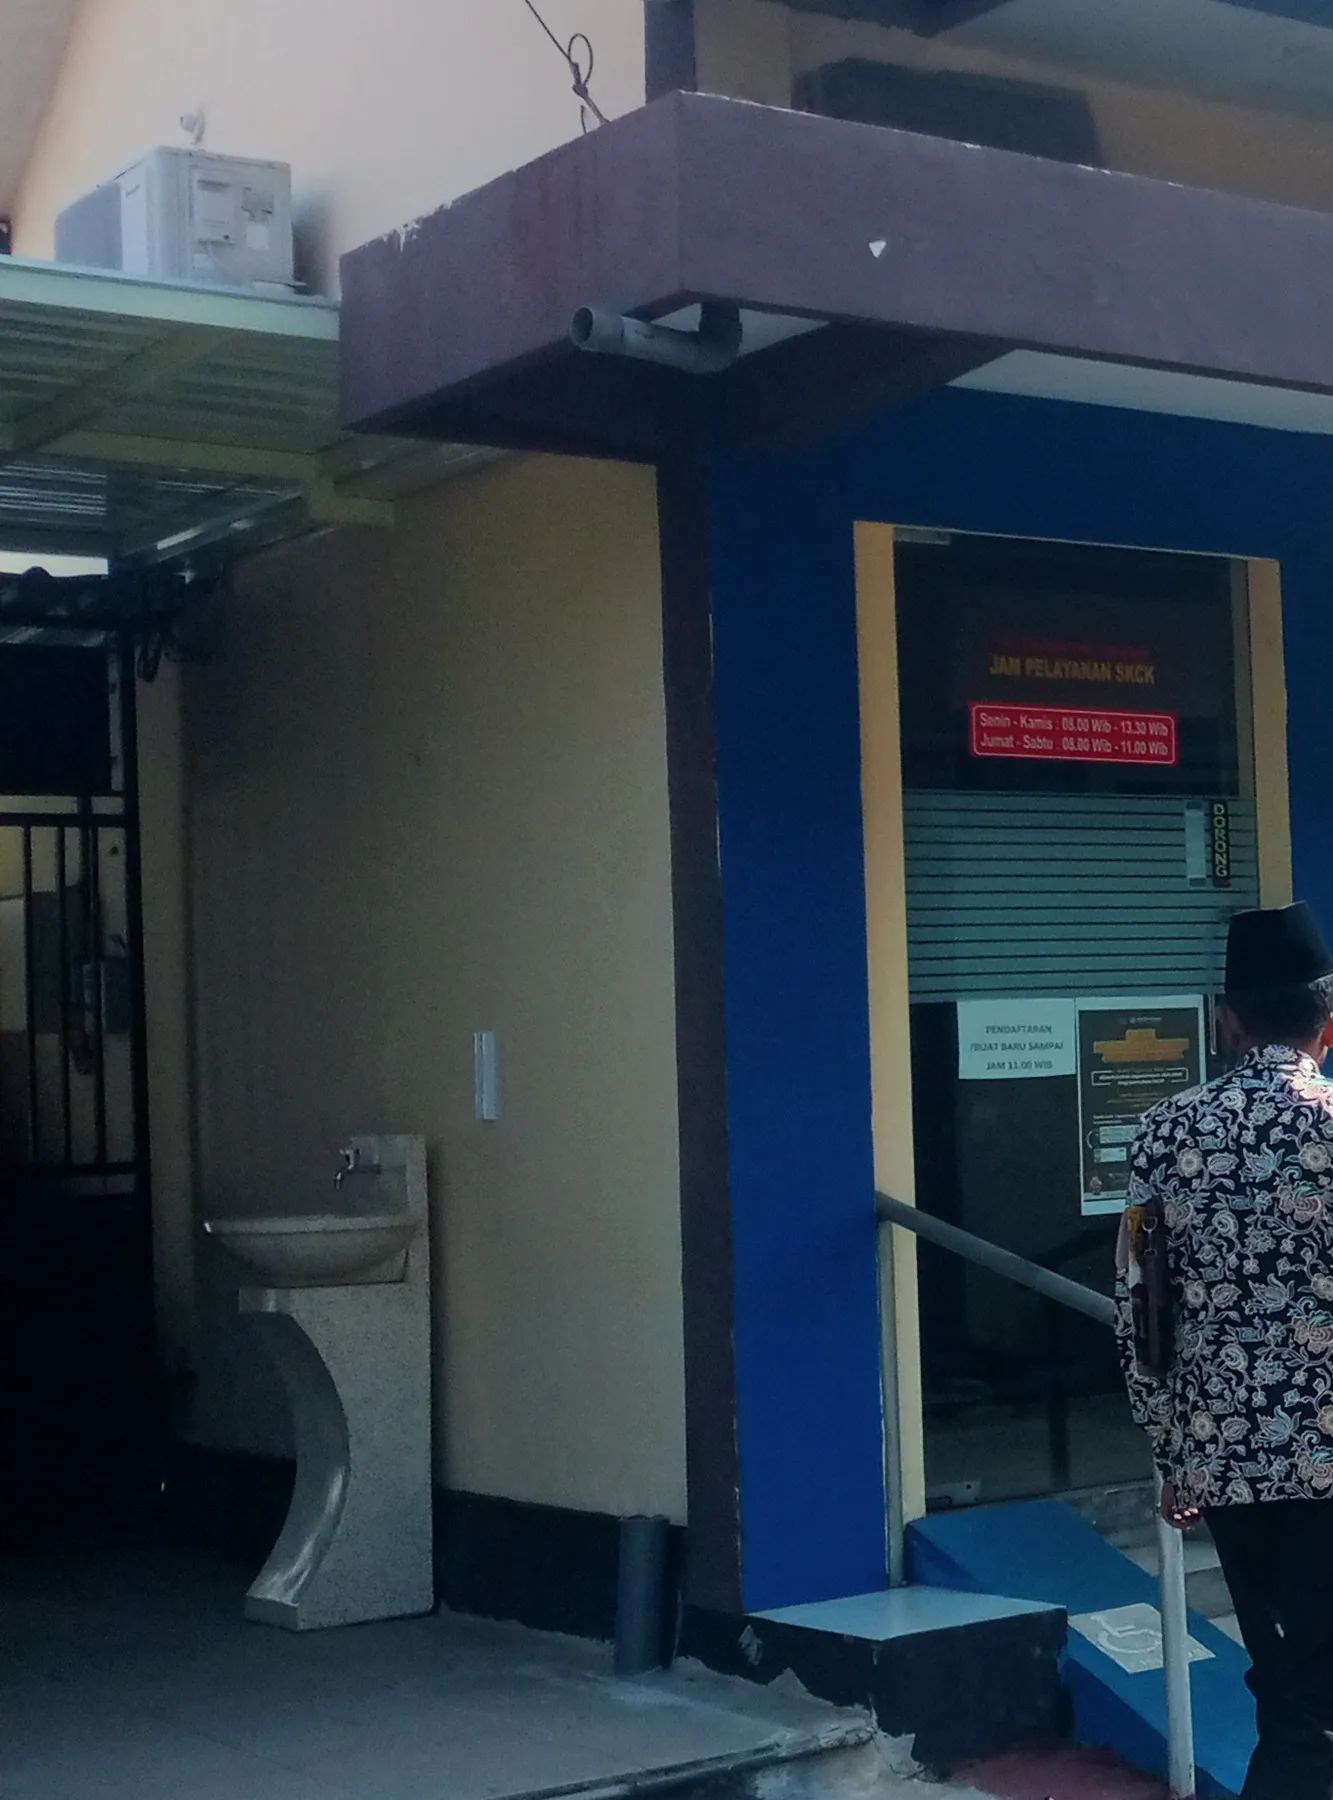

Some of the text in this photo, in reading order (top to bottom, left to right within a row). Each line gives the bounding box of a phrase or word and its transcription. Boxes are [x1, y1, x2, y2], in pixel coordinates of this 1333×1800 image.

[990, 655, 1156, 685] JAM PELAYANAN SKCK
[980, 712, 1011, 727] Senin
[1020, 714, 1053, 730] Kamis
[1091, 718, 1112, 733] Wib
[1121, 721, 1147, 735] 13.30
[1149, 722, 1169, 736] Wib
[980, 732, 1014, 748] Jumat
[1023, 735, 1053, 750] Sabtu
[1092, 738, 1112, 752] Wib
[1121, 740, 1147, 754] 11.00
[1149, 742, 1169, 756] Wib
[1213, 803, 1228, 877] DORONG
[985, 1025, 1052, 1034] PENDAFTARAN
[1001, 1042, 1026, 1051] BARU
[1028, 1042, 1064, 1051] SAMPAI
[986, 1061, 1006, 1070] JAM
[1034, 1060, 1053, 1069] WIB
